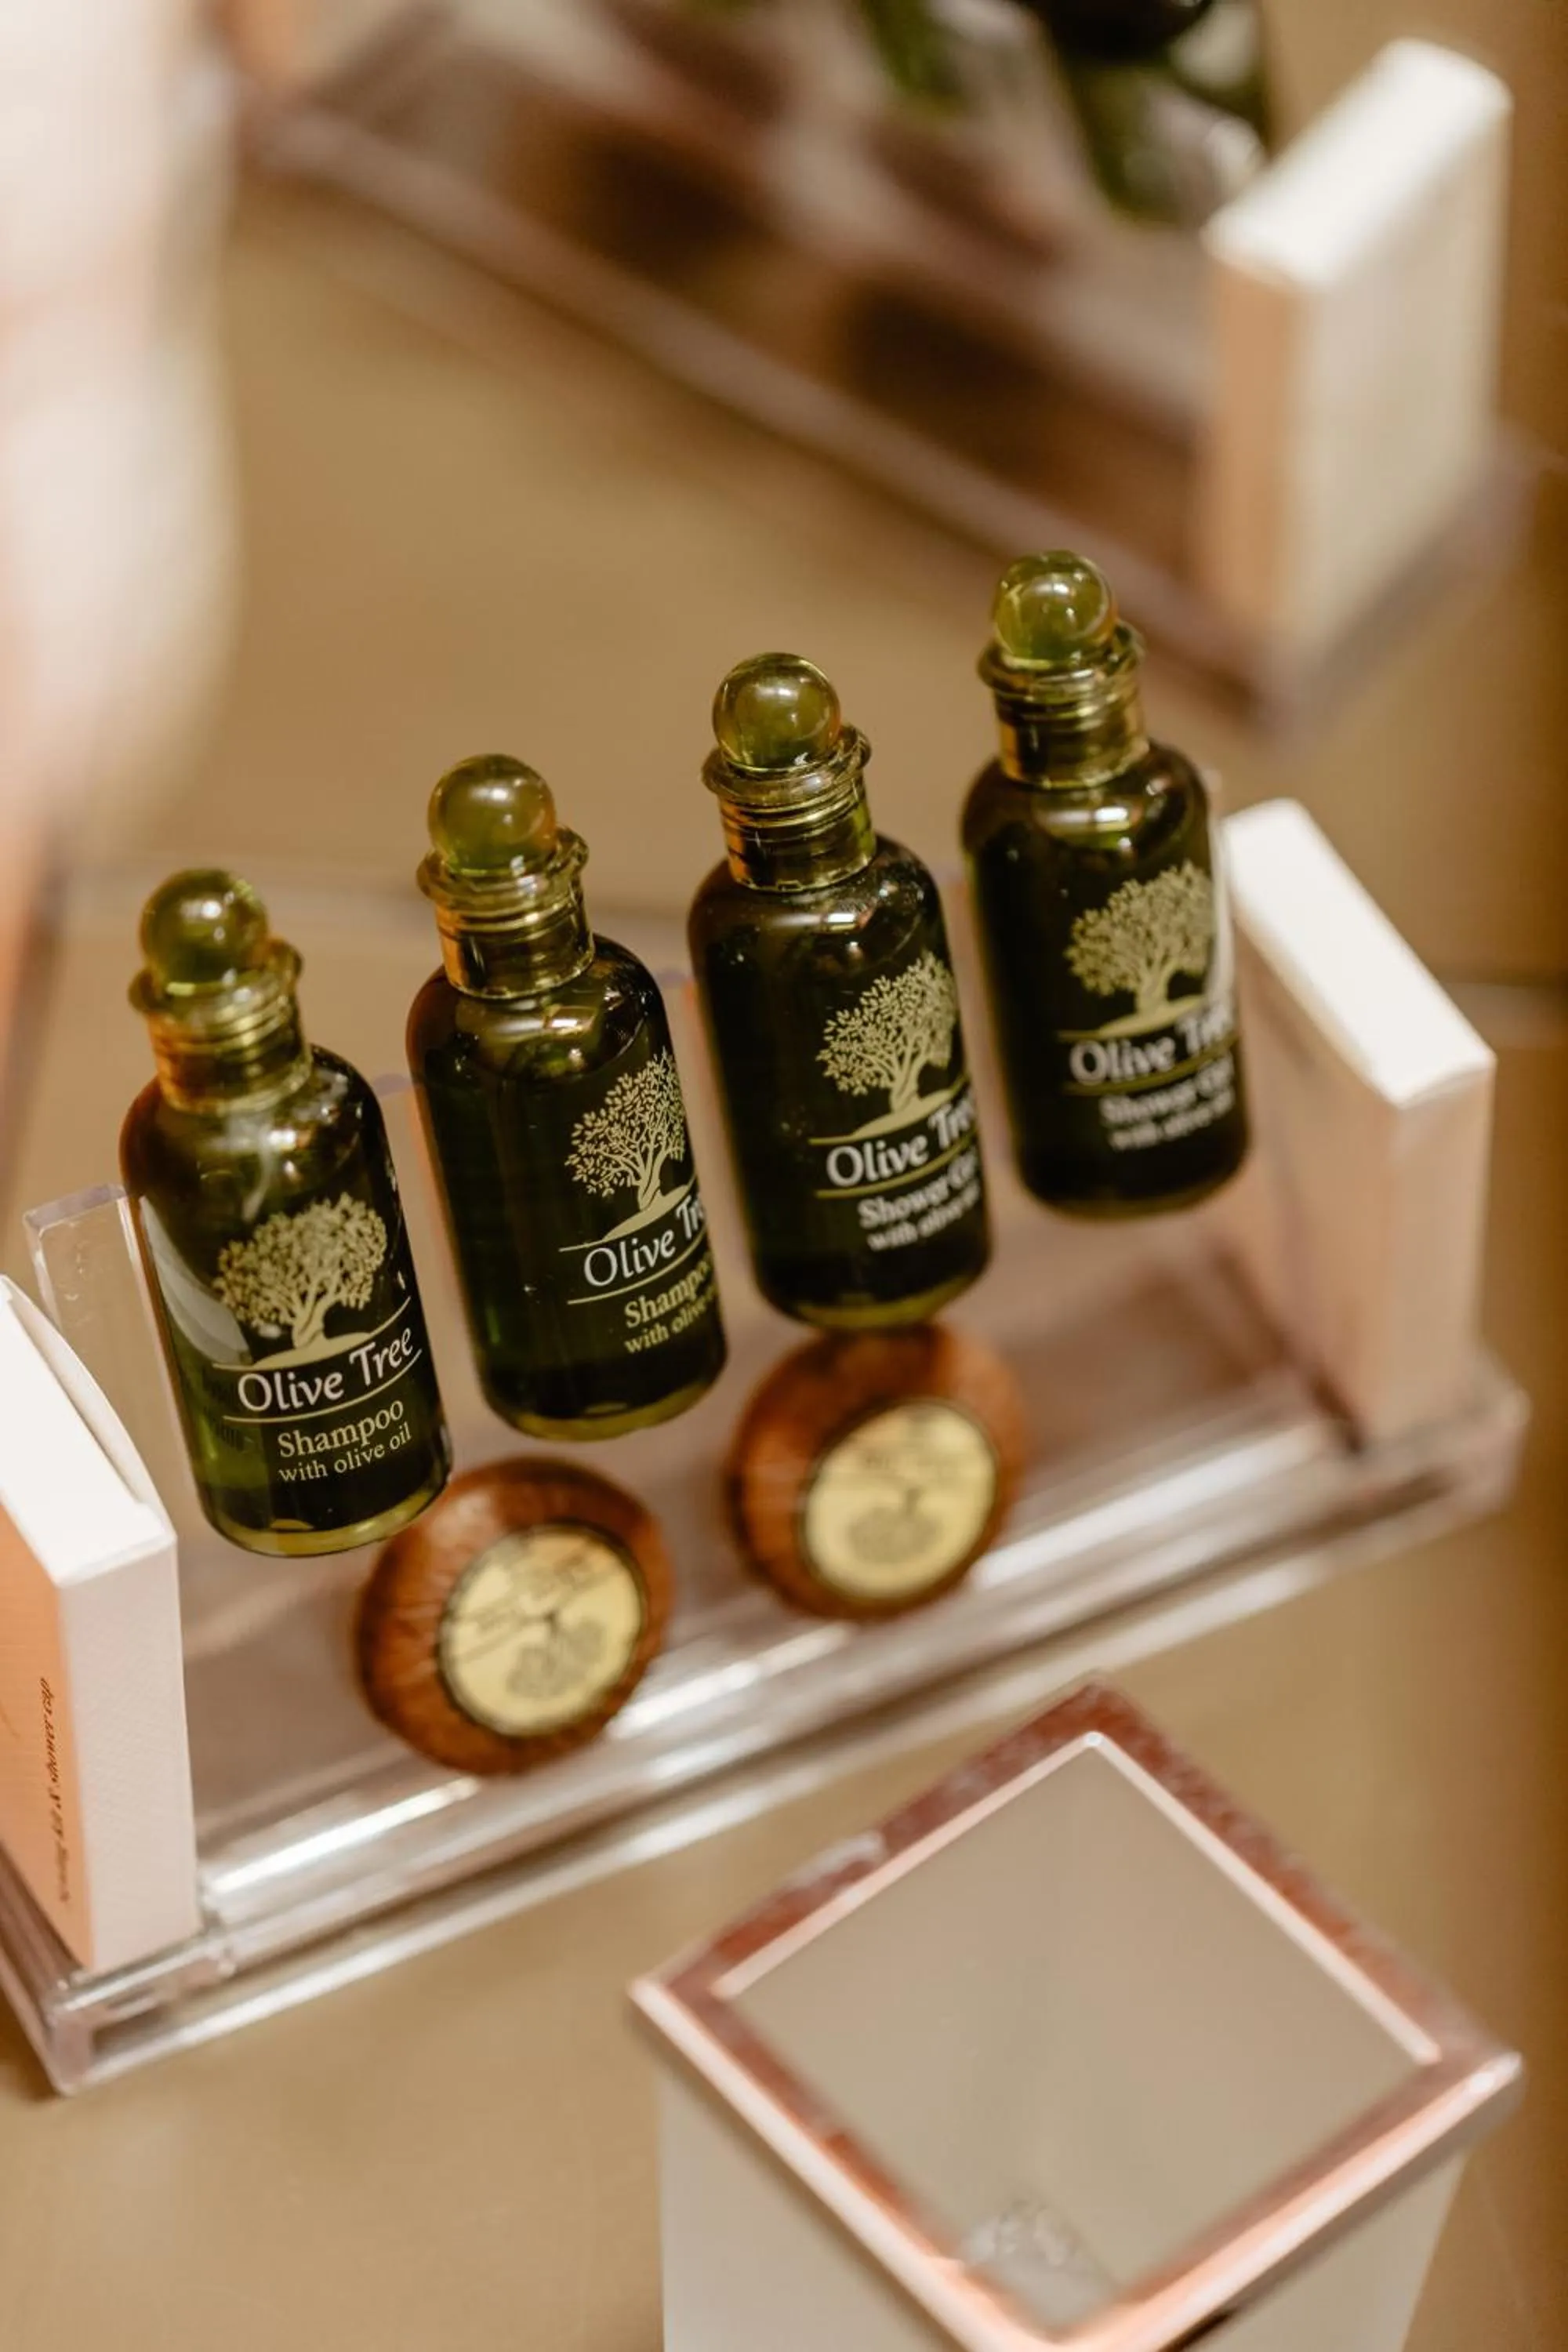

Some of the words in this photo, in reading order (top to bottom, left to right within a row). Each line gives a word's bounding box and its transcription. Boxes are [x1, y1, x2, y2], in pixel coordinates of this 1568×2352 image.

[1070, 1037, 1175, 1085] Olive
[826, 1135, 928, 1186] Olive
[857, 1177, 948, 1229] Shower
[584, 1229, 676, 1286] Olive
[867, 1220, 917, 1250] with
[625, 1323, 669, 1352] with
[238, 1372, 344, 1411] Olive
[349, 1328, 413, 1385] Tree
[278, 1400, 404, 1457] Shampoo
[279, 1461, 328, 1481] with
[334, 1444, 384, 1473] olive
[390, 1421, 412, 1450] oil
[40, 1677, 54, 1715] cap
